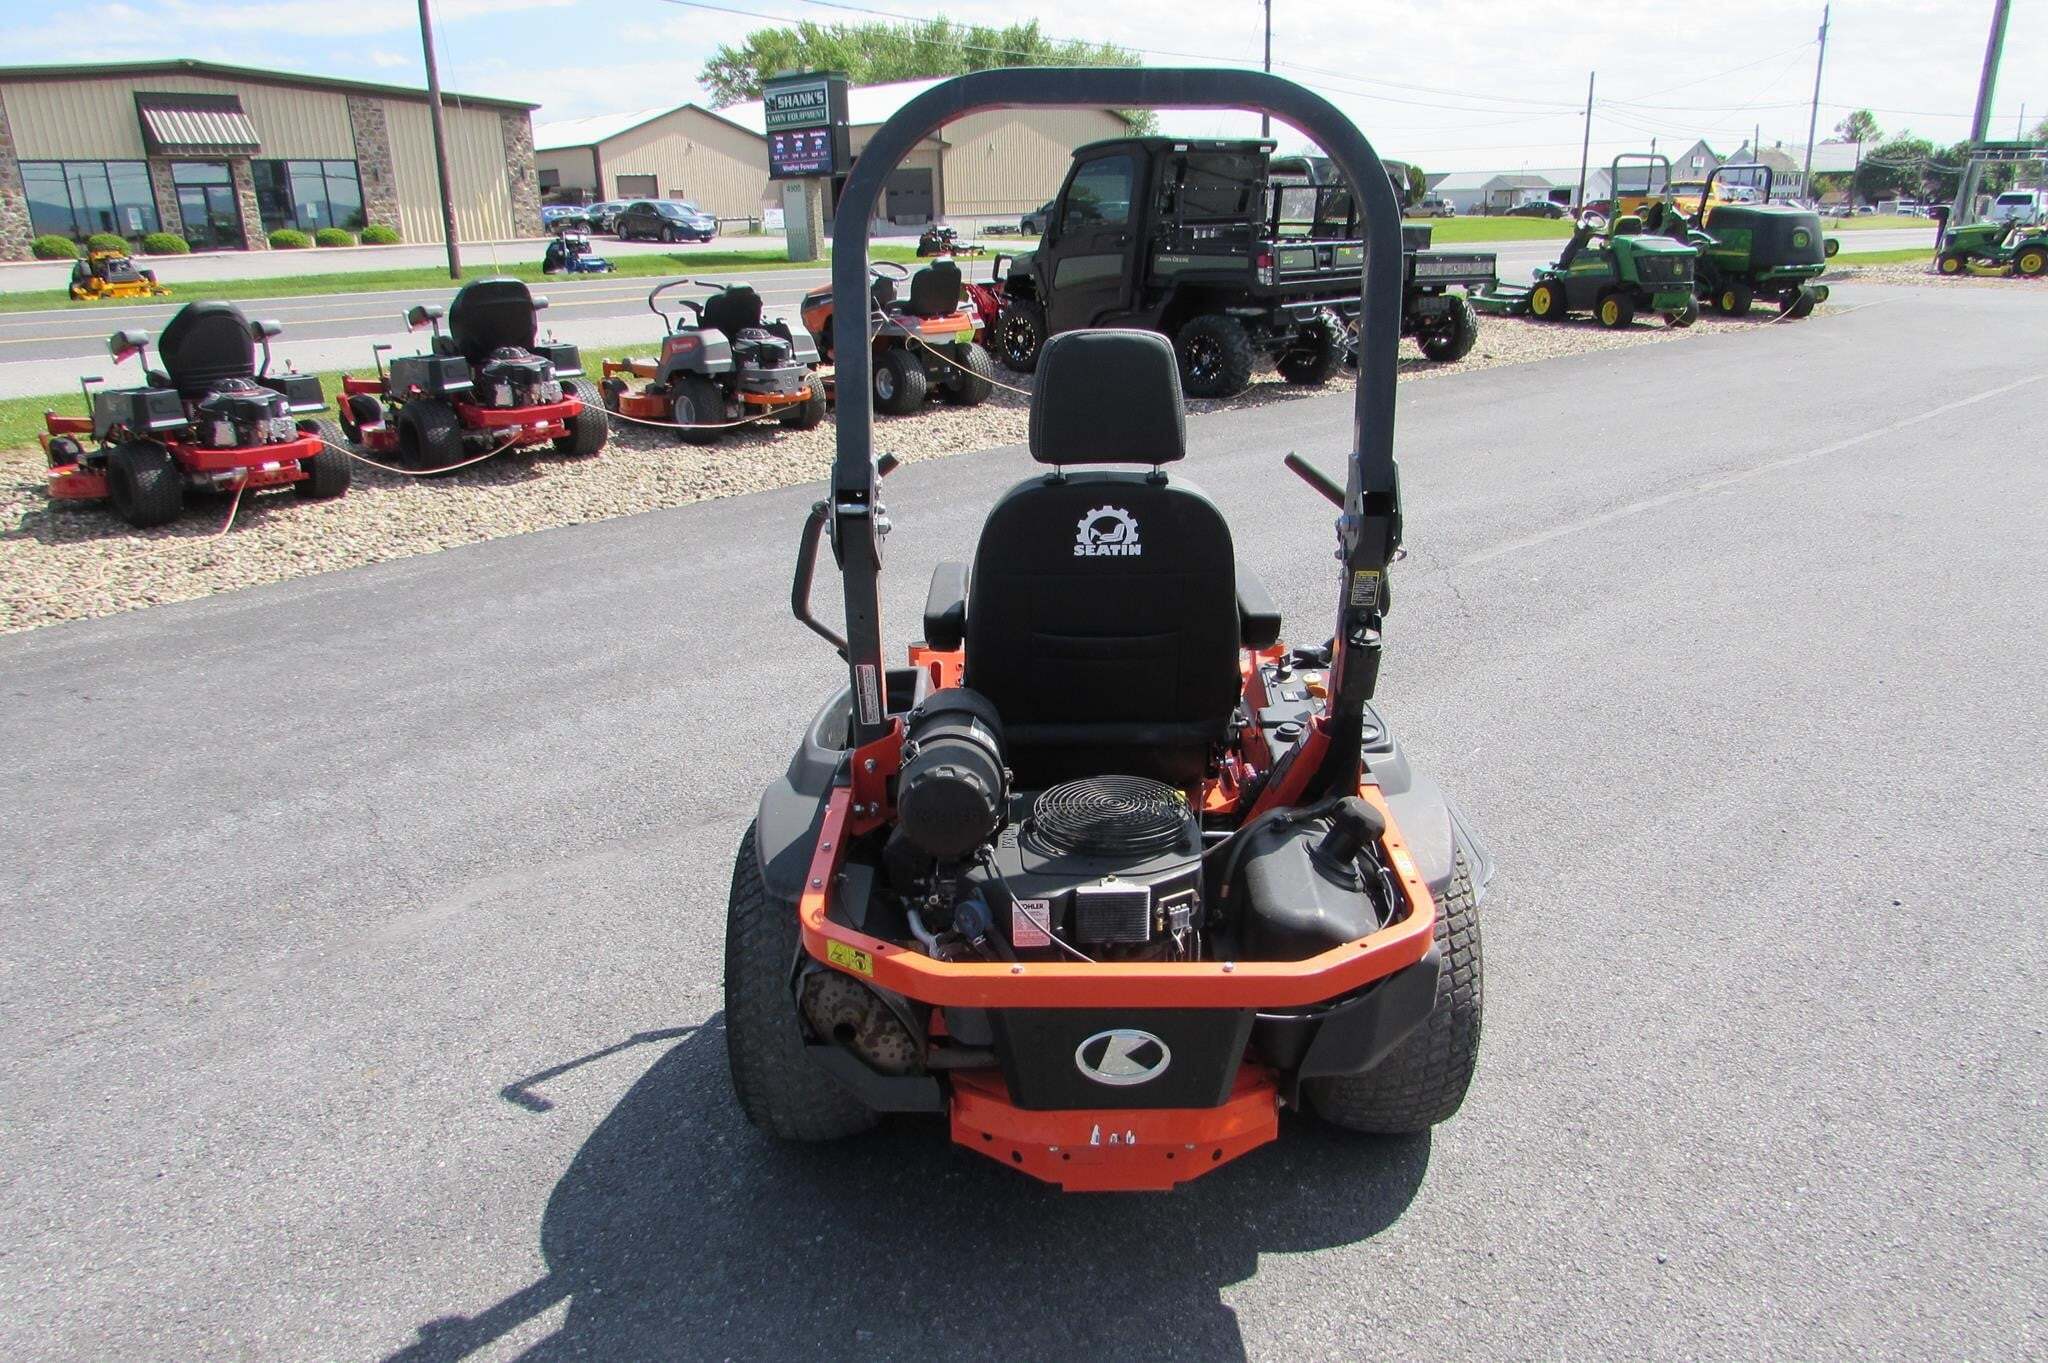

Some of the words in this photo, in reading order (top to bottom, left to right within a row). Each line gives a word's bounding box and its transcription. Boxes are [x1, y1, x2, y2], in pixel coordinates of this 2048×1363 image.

[777, 91, 824, 109] SHANK'S
[767, 114, 786, 124] LAWN
[787, 109, 825, 120] EQUIPMENT
[1074, 544, 1141, 556] SEATIN
